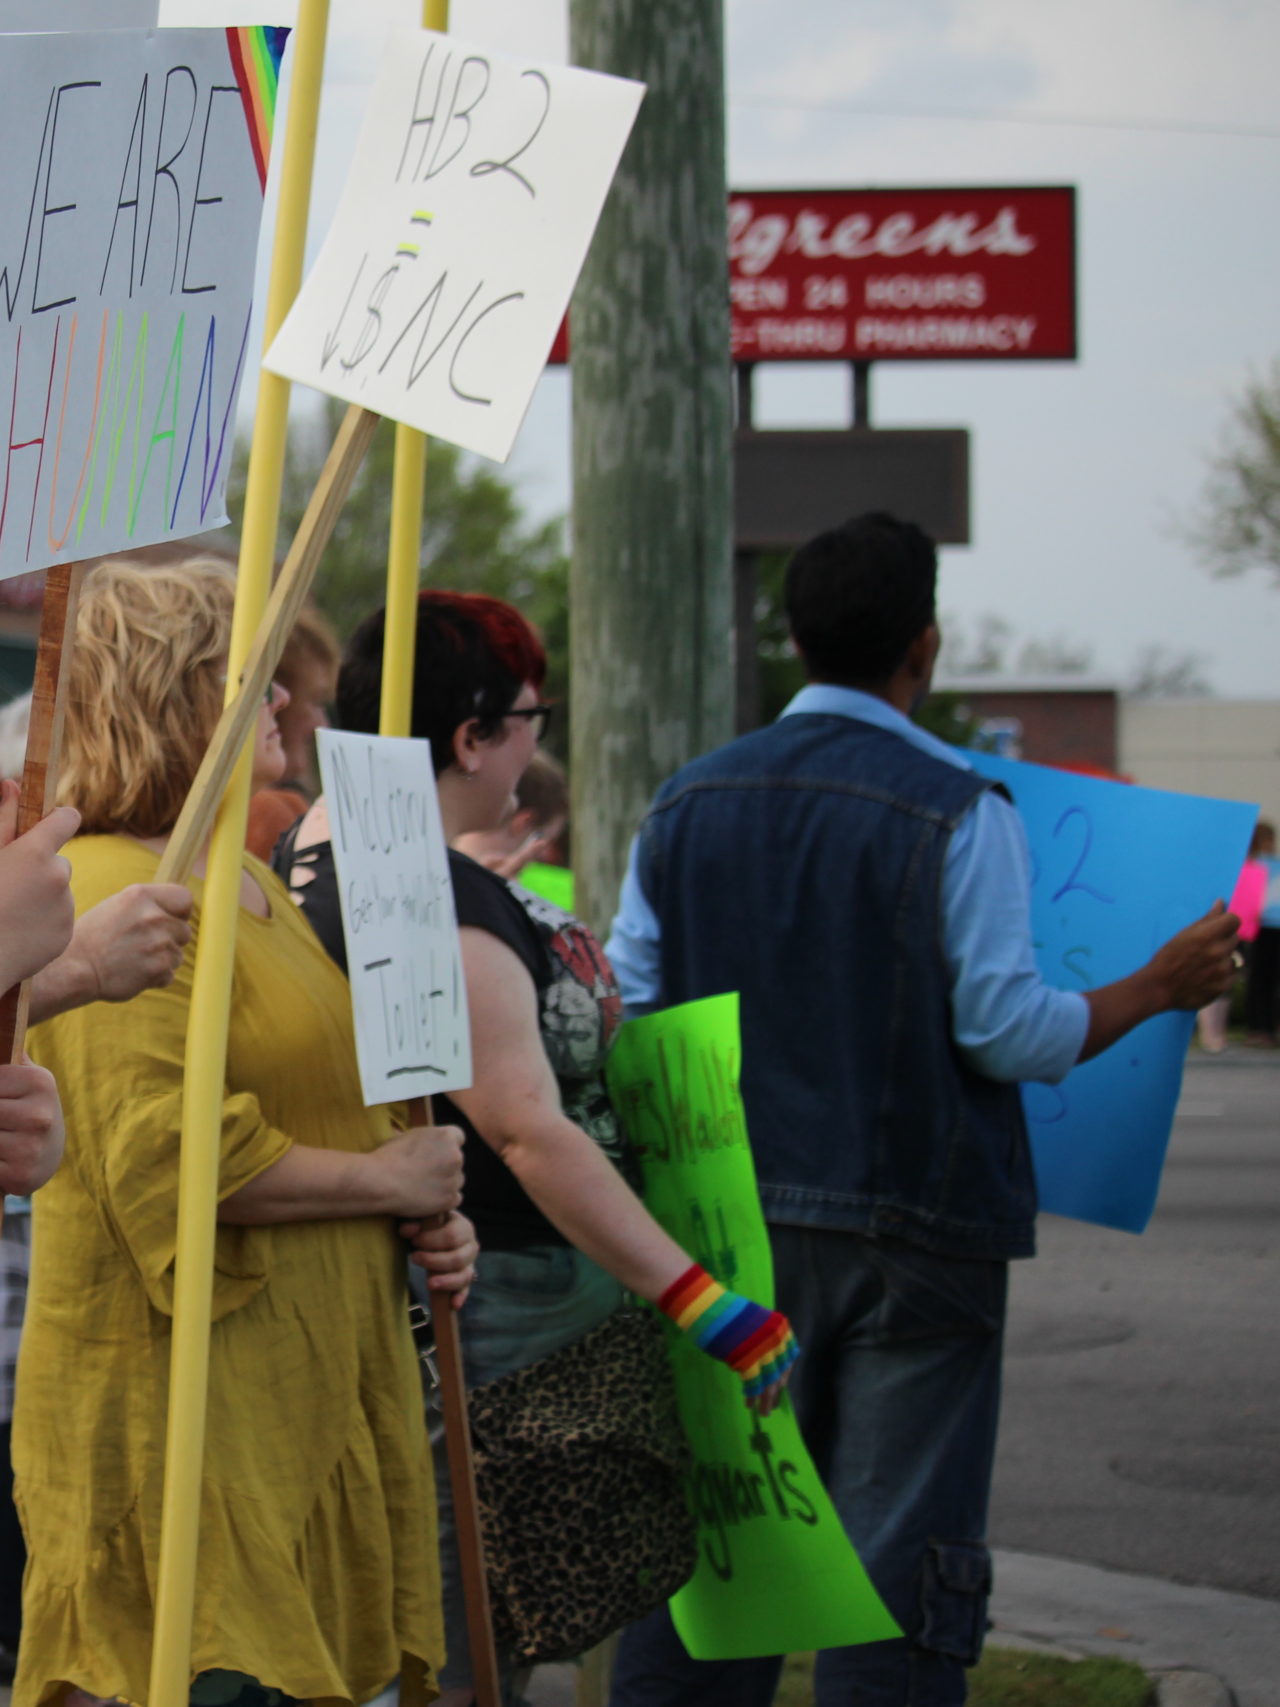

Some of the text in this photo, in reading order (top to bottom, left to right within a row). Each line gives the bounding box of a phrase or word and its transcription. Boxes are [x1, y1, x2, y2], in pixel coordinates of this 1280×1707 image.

[395, 42, 551, 199] HB2
[100, 66, 242, 298] ARE
[803, 274, 849, 310] 24
[864, 273, 986, 310] HOURS
[855, 316, 1035, 351] PHARMACY
